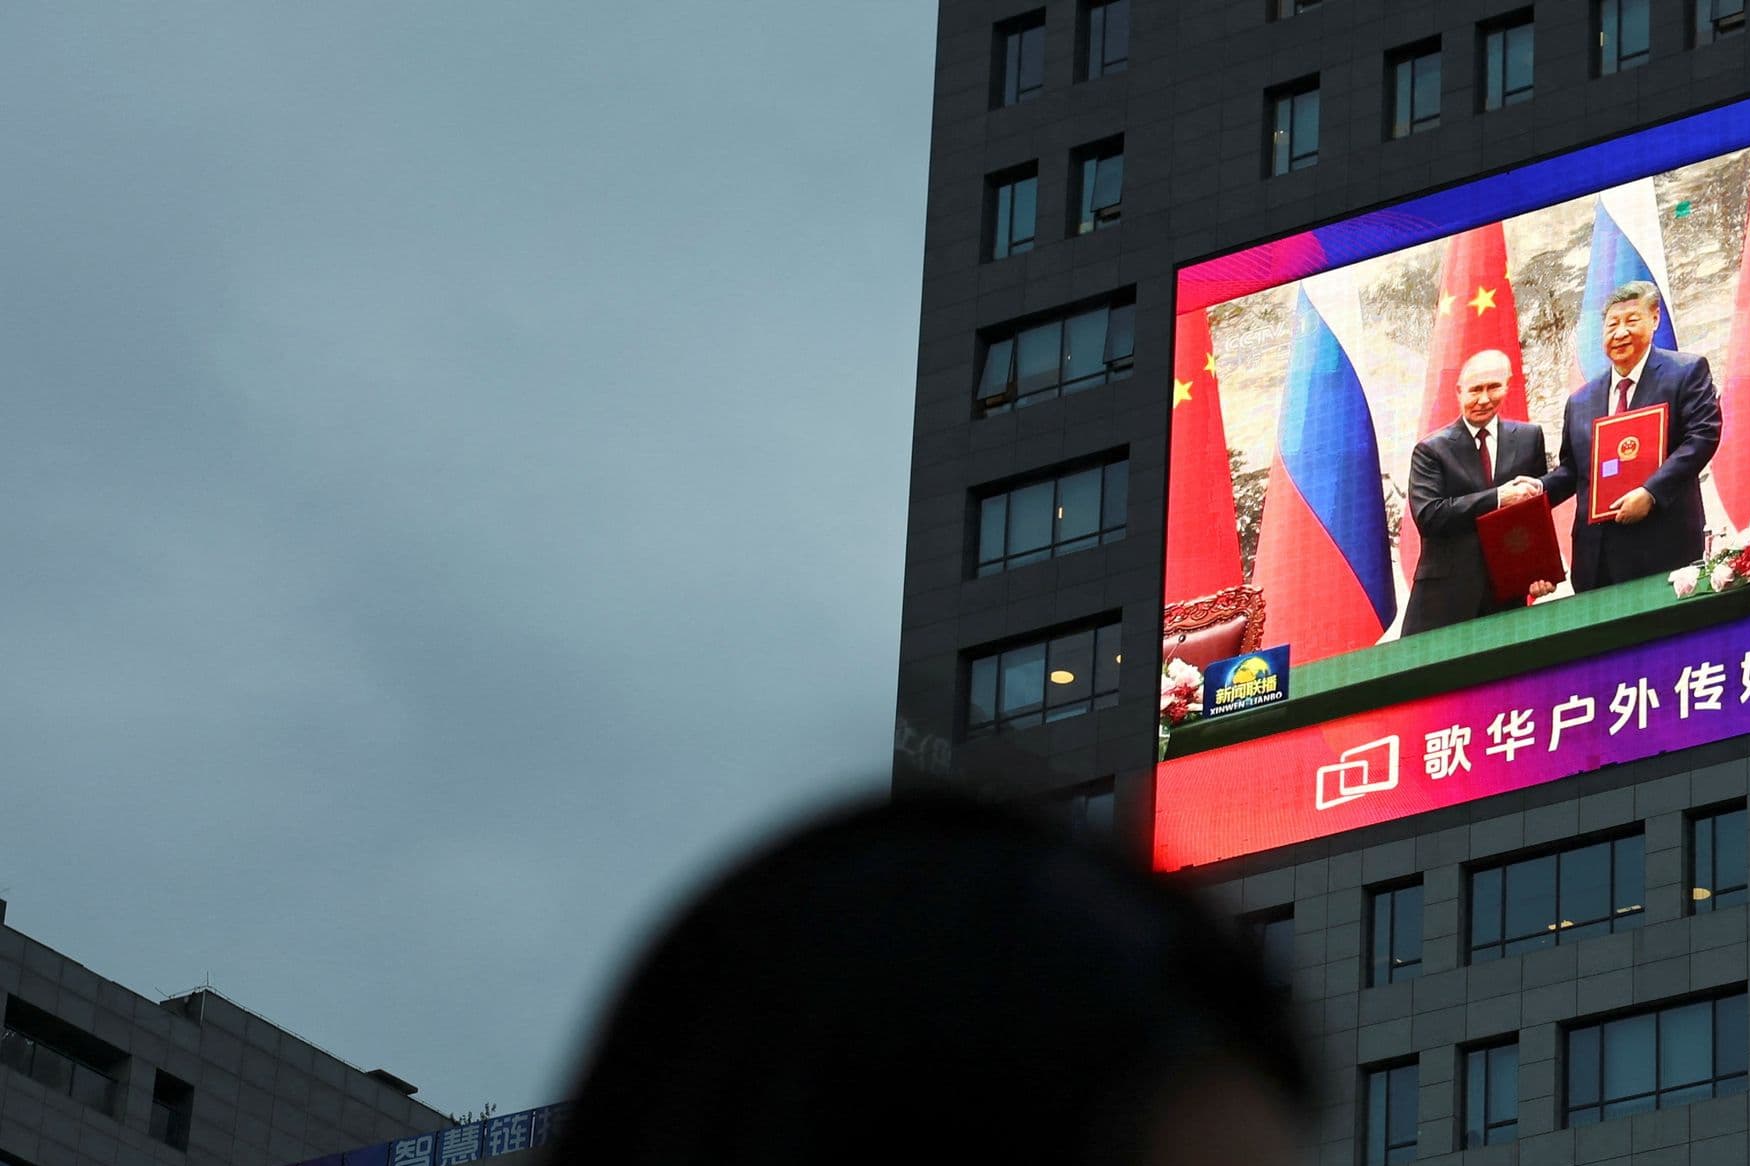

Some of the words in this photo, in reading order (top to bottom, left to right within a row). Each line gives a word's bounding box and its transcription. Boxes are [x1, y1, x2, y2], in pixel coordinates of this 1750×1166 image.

[1215, 675, 1277, 704] 新闻联播
[1210, 700, 1246, 716] XINWEN
[1249, 691, 1283, 707] LIANBO
